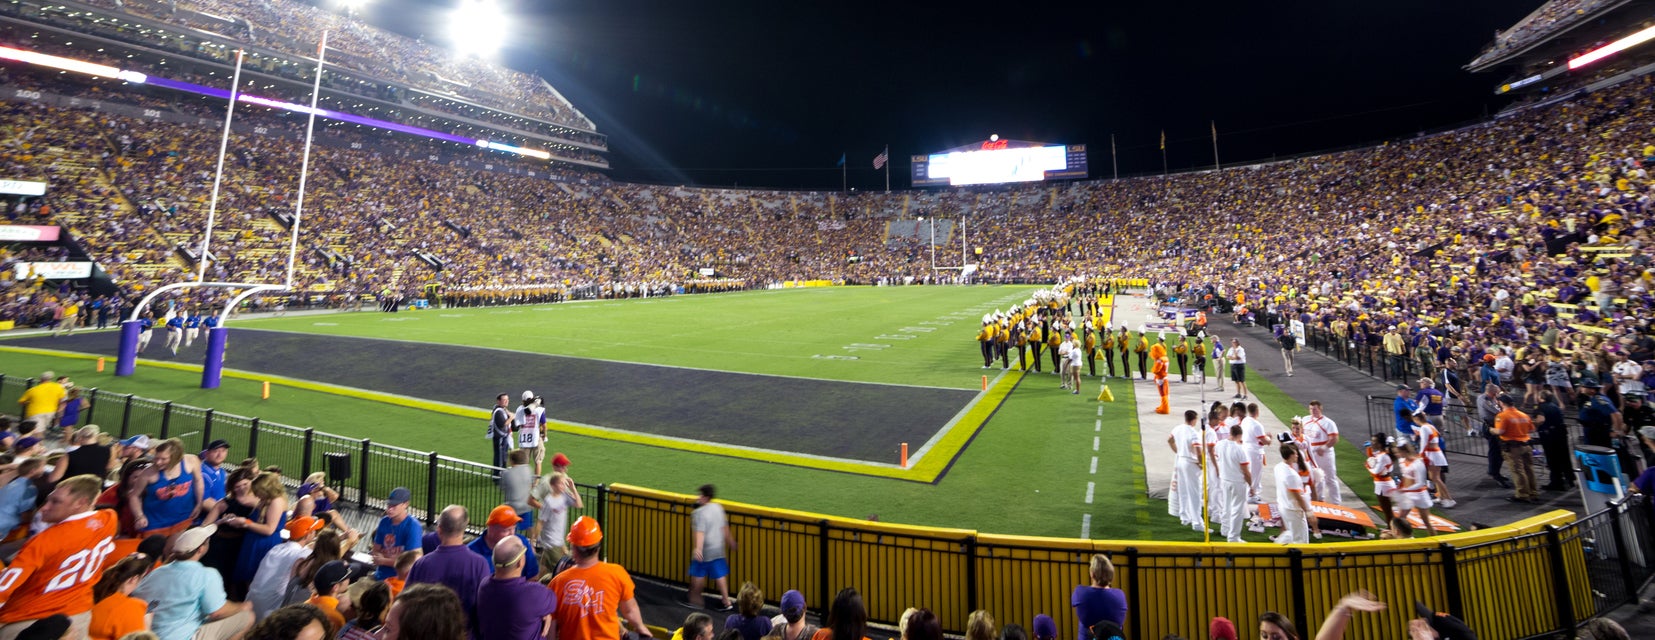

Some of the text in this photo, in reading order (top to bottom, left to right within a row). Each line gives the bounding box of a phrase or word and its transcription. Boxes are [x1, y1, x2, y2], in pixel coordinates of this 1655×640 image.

[1067, 145, 1085, 153] LSU
[912, 155, 928, 163] LSU
[43, 535, 116, 594] 20
